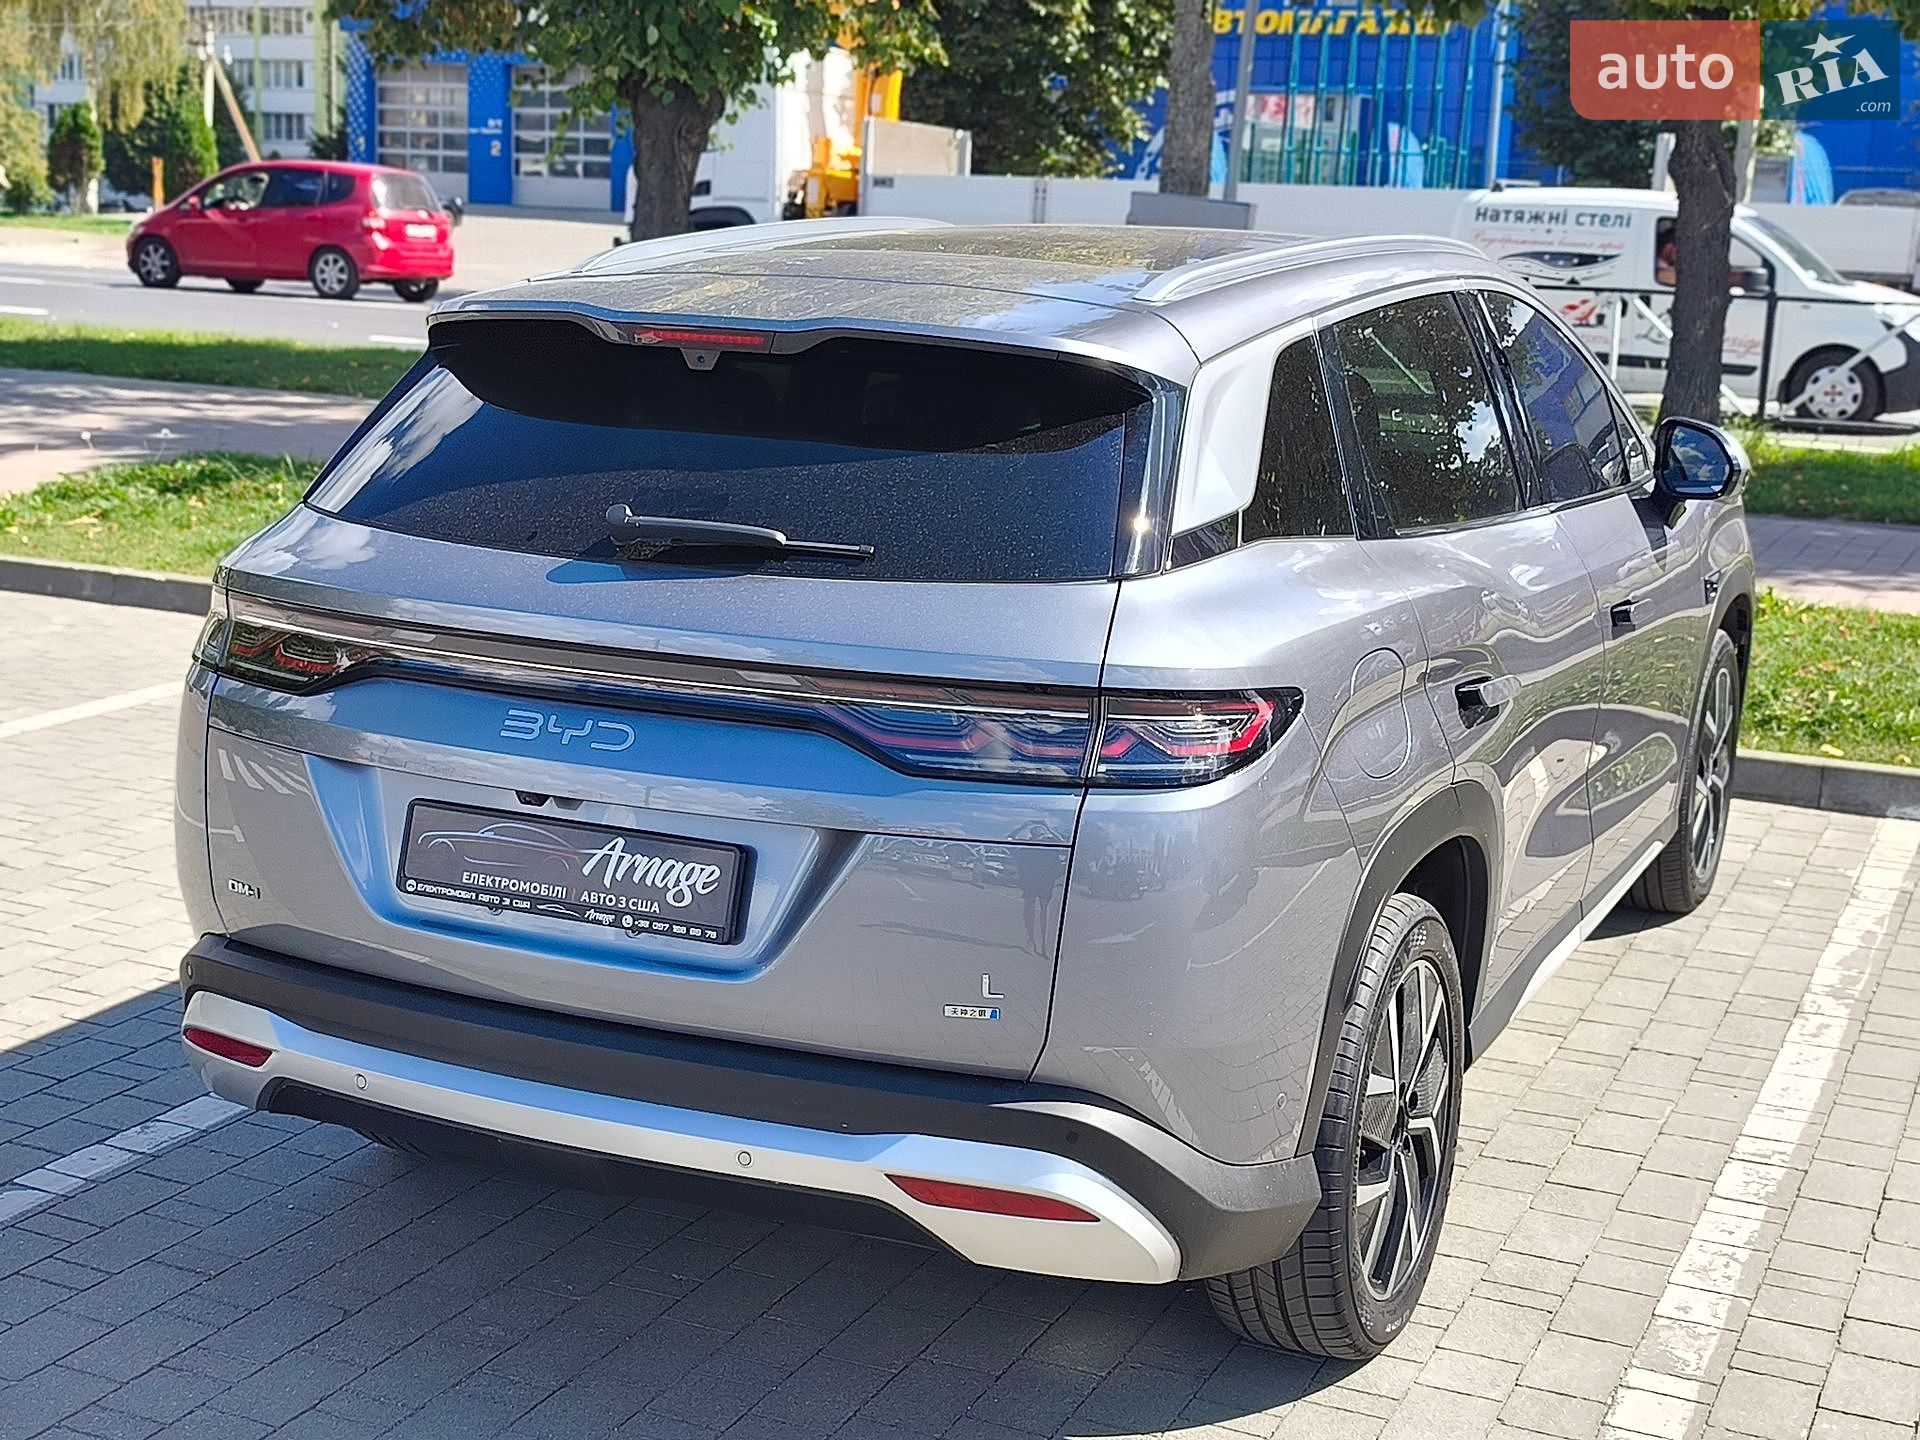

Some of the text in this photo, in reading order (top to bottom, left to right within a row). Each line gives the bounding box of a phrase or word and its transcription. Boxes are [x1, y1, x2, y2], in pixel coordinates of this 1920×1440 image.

[1575, 211, 1632, 229] стелі
[500, 708, 637, 752] BYD
[462, 871, 568, 900] ЕЛЕКТРОМОБІЛІ
[580, 890, 617, 907] АВТО
[628, 898, 661, 914] США
[581, 836, 721, 907] Arnage
[982, 973, 1005, 999] L
